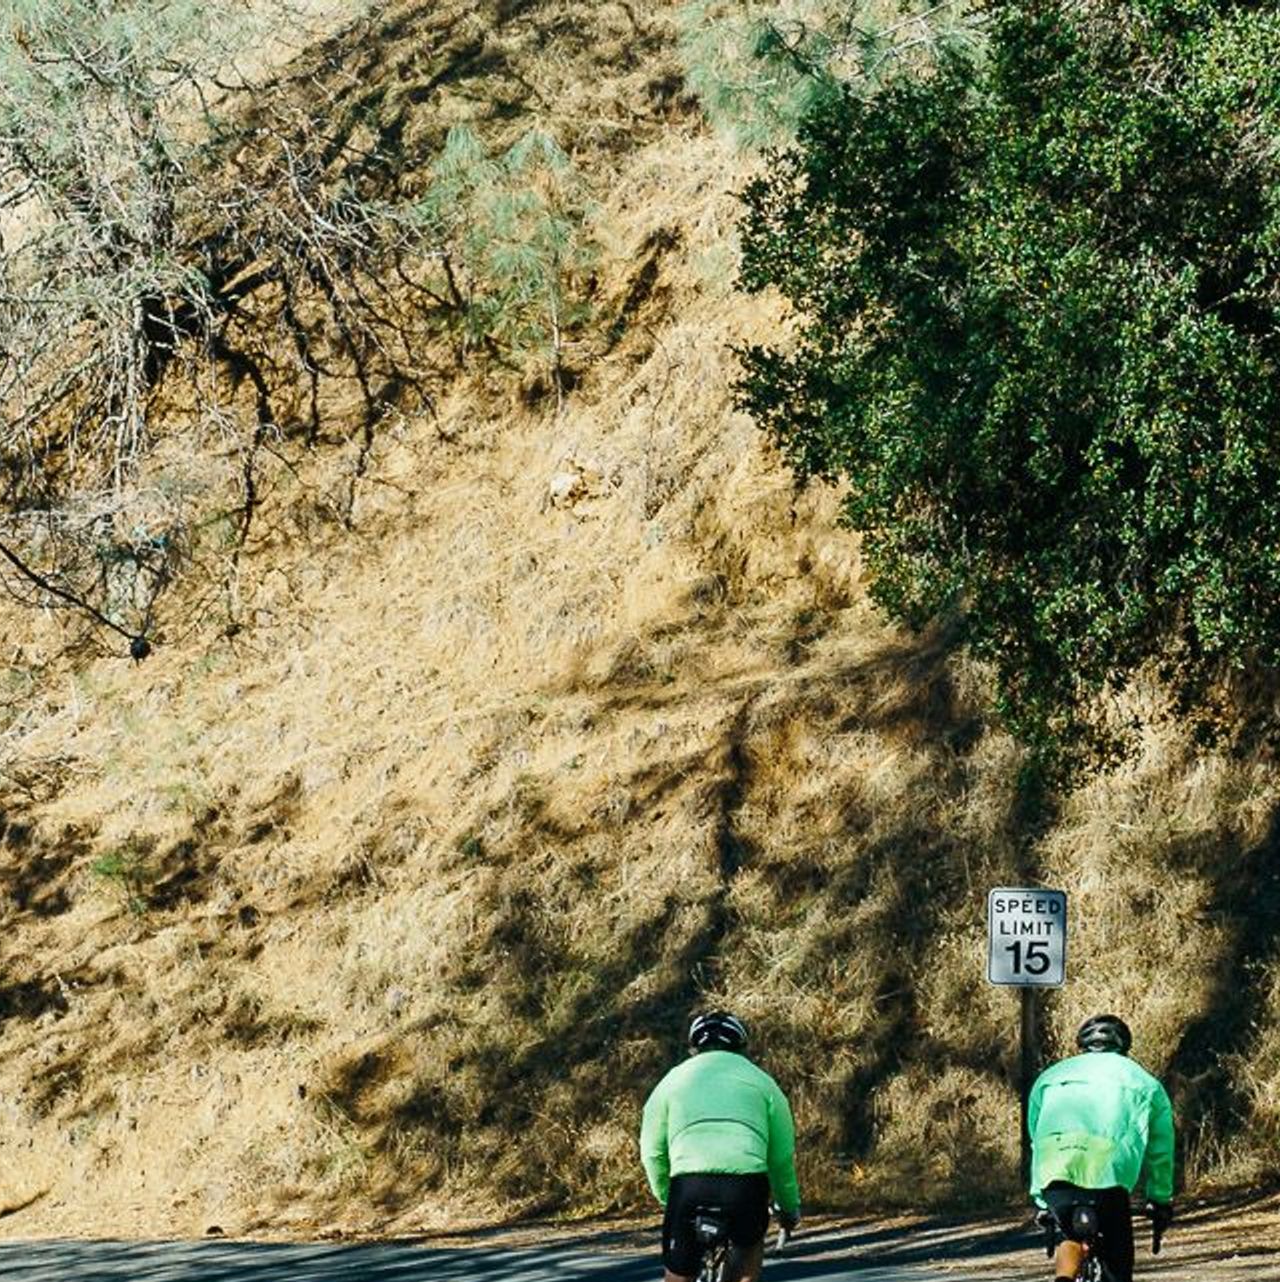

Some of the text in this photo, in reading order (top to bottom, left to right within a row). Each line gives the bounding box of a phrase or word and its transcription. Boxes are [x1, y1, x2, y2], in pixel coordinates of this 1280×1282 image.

[995, 899, 1061, 914] SPEED
[1000, 921, 1054, 935] LIMIT
[1005, 941, 1051, 975] 15
